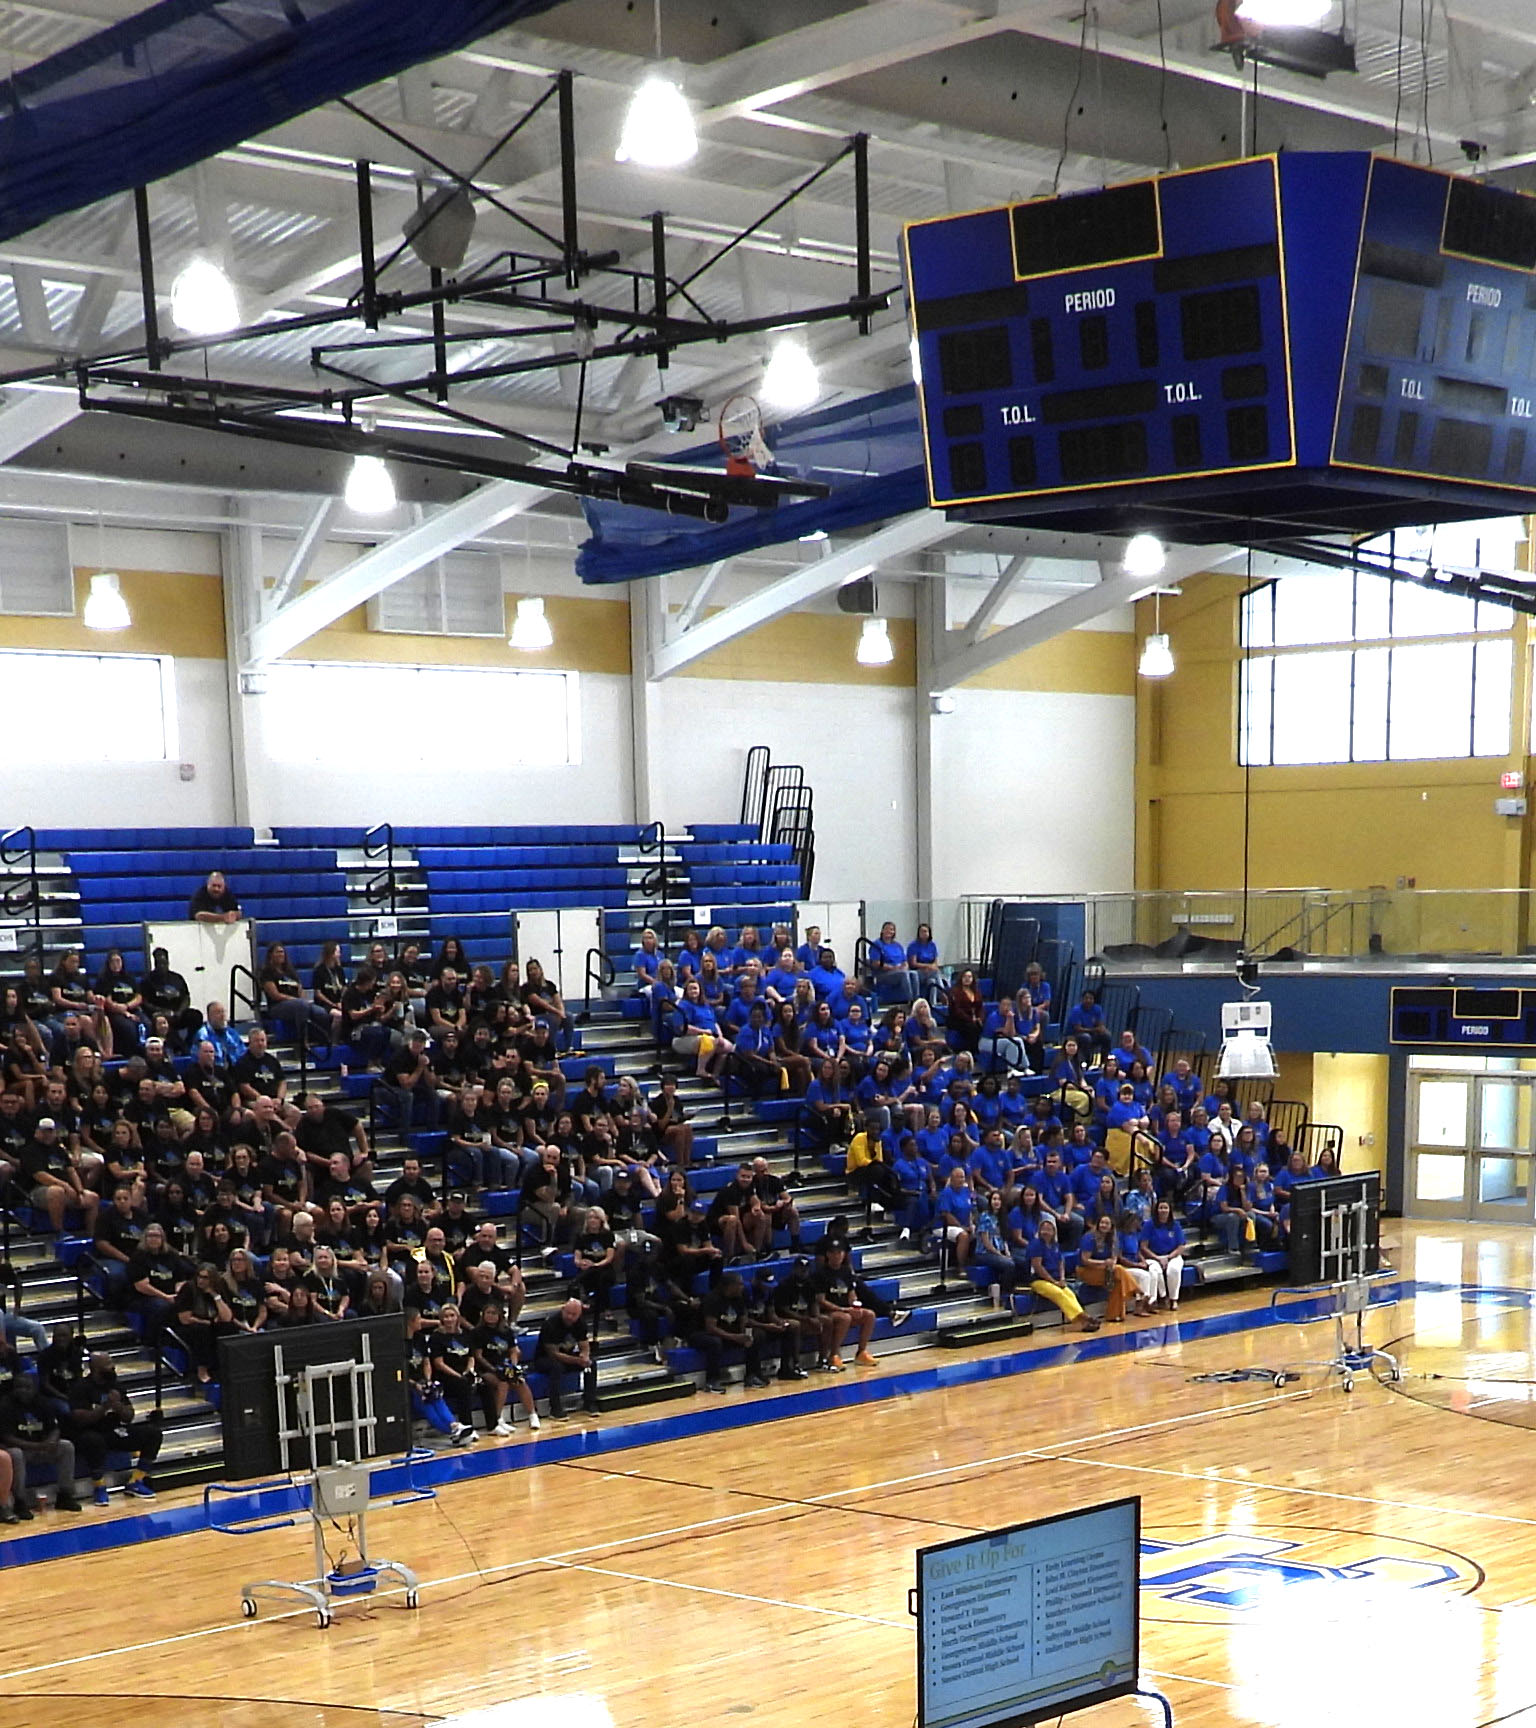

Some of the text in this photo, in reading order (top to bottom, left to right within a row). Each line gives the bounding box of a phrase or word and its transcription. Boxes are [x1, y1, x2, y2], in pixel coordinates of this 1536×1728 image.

[1065, 288, 1116, 314] PERIOD
[1466, 283, 1502, 308] PERIOD
[1164, 384, 1203, 405] T.O.L.
[1000, 405, 1036, 425] T.O.L.
[1461, 1025, 1490, 1037] PERIOD
[929, 1558, 960, 1579] Give
[966, 1553, 976, 1571] It
[980, 1548, 999, 1570] Up
